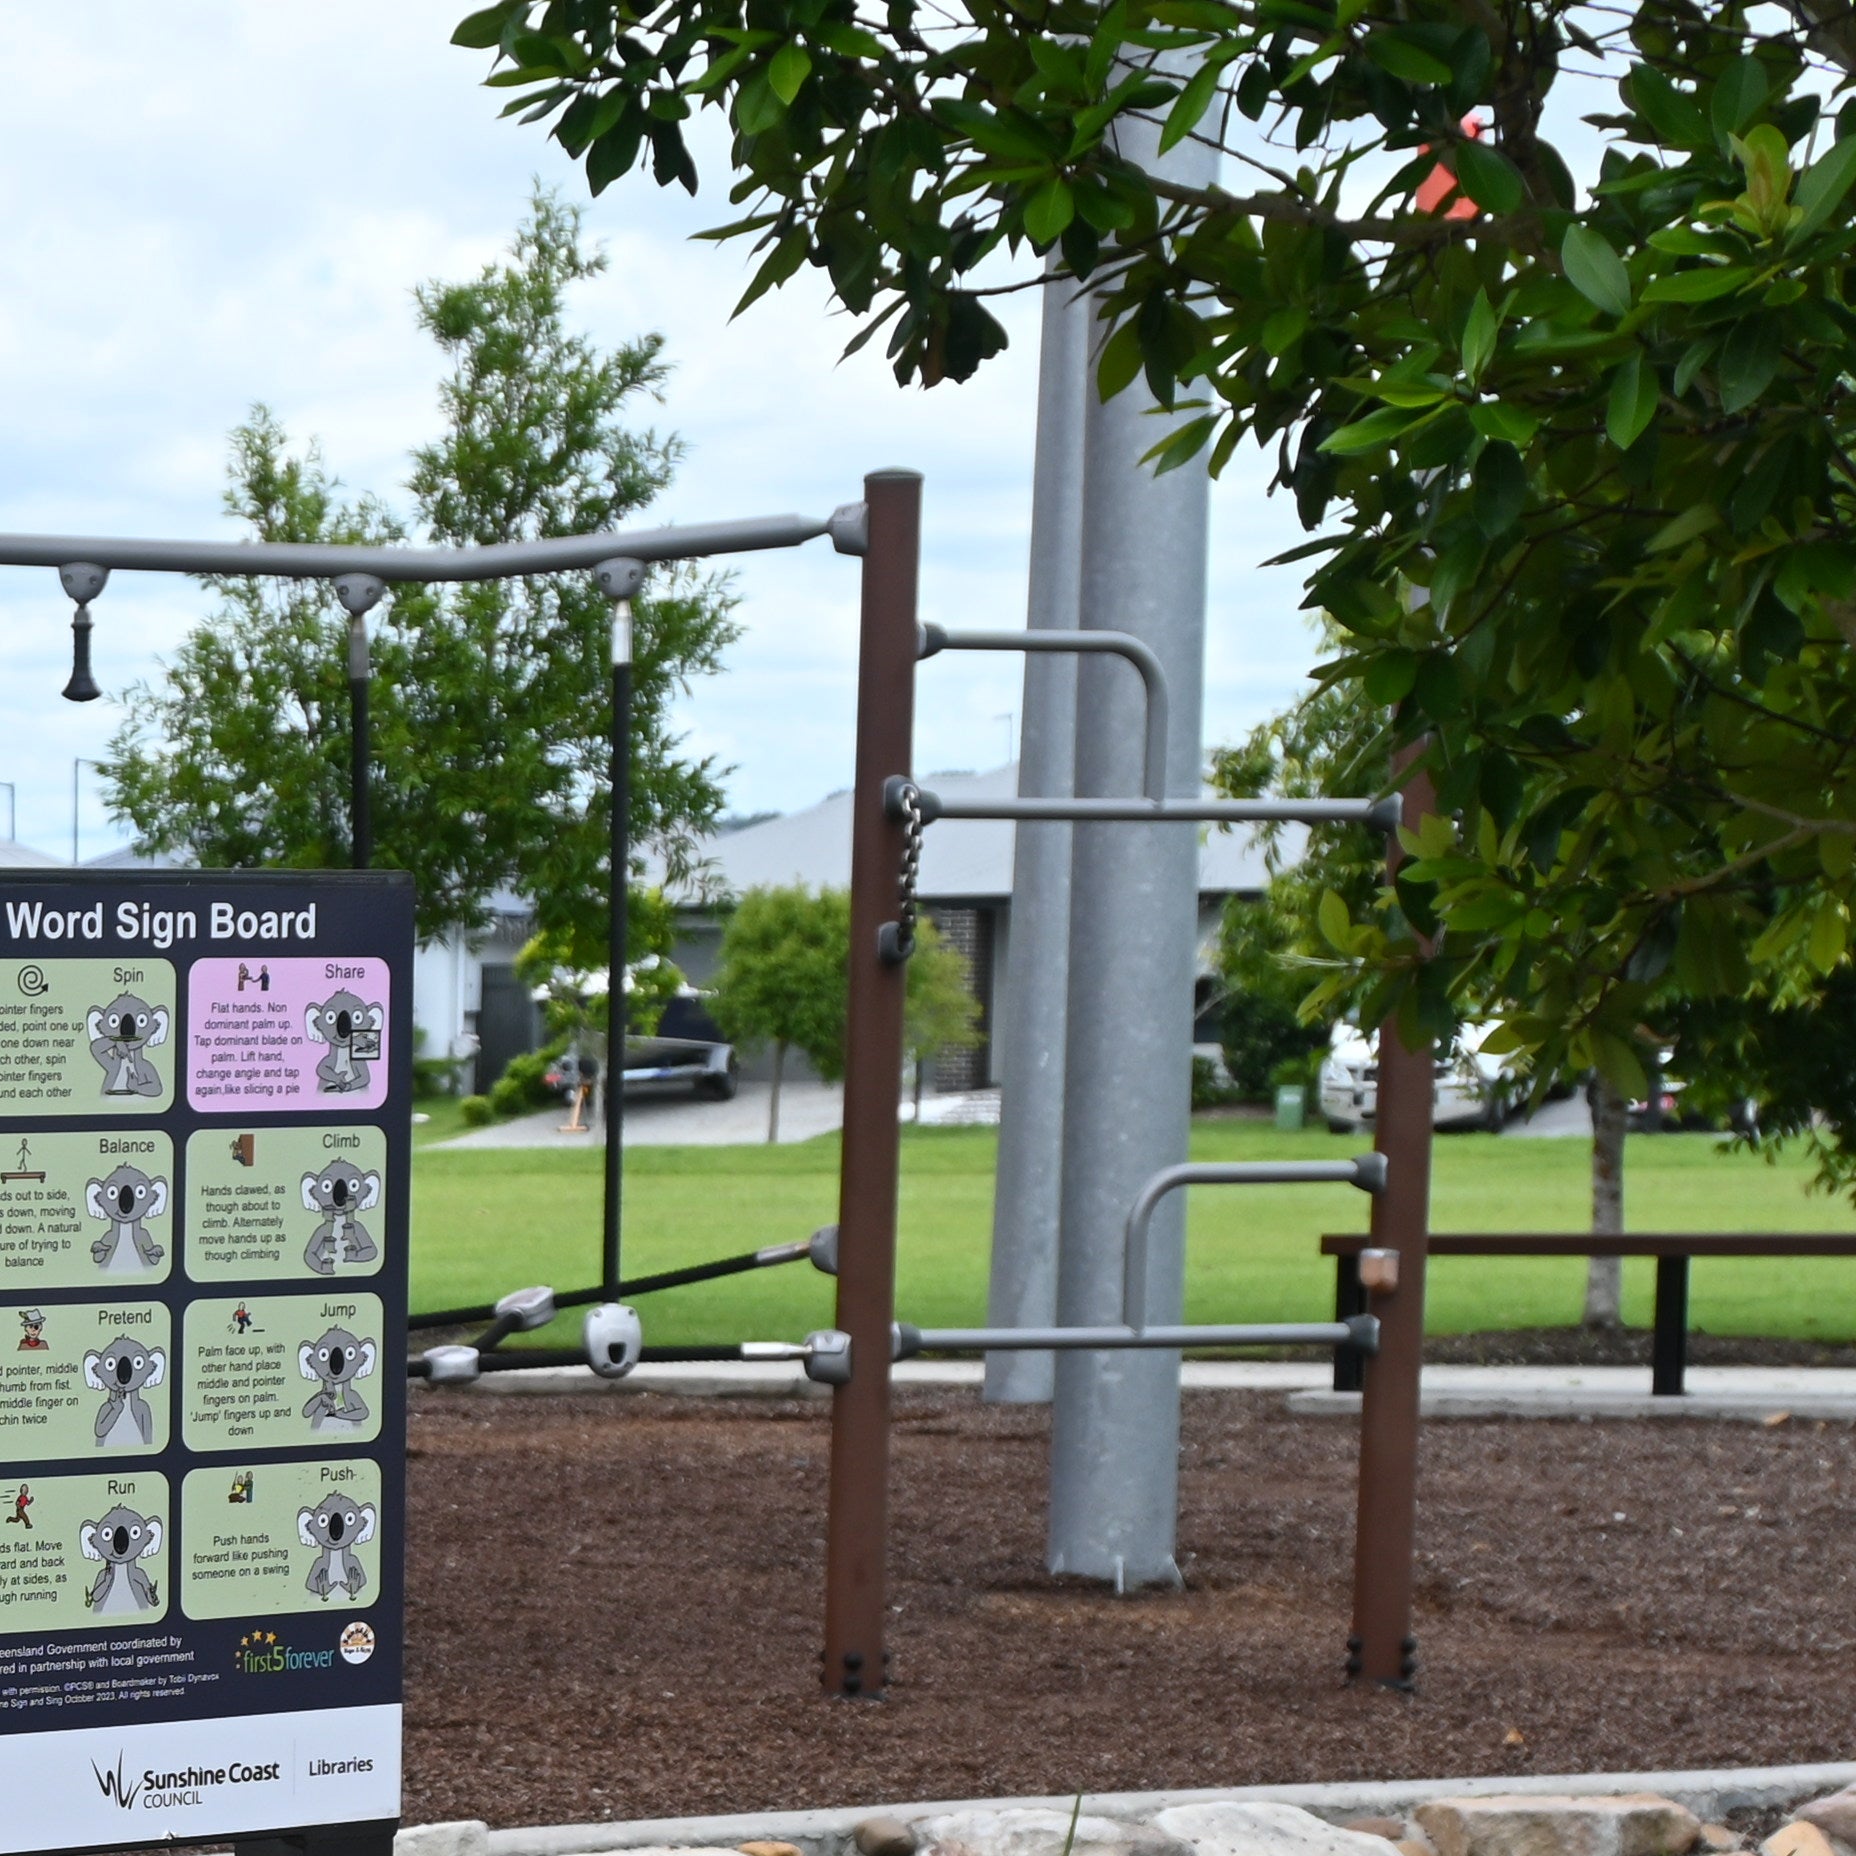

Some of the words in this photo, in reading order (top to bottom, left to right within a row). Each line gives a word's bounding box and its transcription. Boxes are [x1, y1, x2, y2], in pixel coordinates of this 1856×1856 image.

[5, 901, 103, 939] Word
[115, 901, 196, 949] Sign
[210, 902, 316, 939] Board
[113, 966, 144, 986] Spin
[324, 963, 365, 979] Share
[99, 1137, 155, 1154] Balance
[322, 1132, 361, 1149] Climb
[14, 1190, 32, 1201] out
[33, 1190, 44, 1201] to
[46, 1188, 70, 1201] side,
[97, 1308, 152, 1325] Pretend
[319, 1302, 356, 1320] Jump
[320, 1465, 354, 1482] Push
[107, 1479, 135, 1495] Run
[212, 1534, 238, 1546] Push
[239, 1532, 270, 1545] hands
[192, 1550, 230, 1564] forward
[231, 1550, 249, 1561] like
[250, 1547, 288, 1562] pushing
[191, 1568, 236, 1580] someone
[238, 1567, 251, 1577] on
[253, 1566, 260, 1576] a
[262, 1564, 290, 1576] swing
[308, 1755, 373, 1776] Libraries
[144, 1766, 225, 1791] Sunshine
[228, 1762, 280, 1783] Coast
[142, 1790, 203, 1809] COUNCIL
